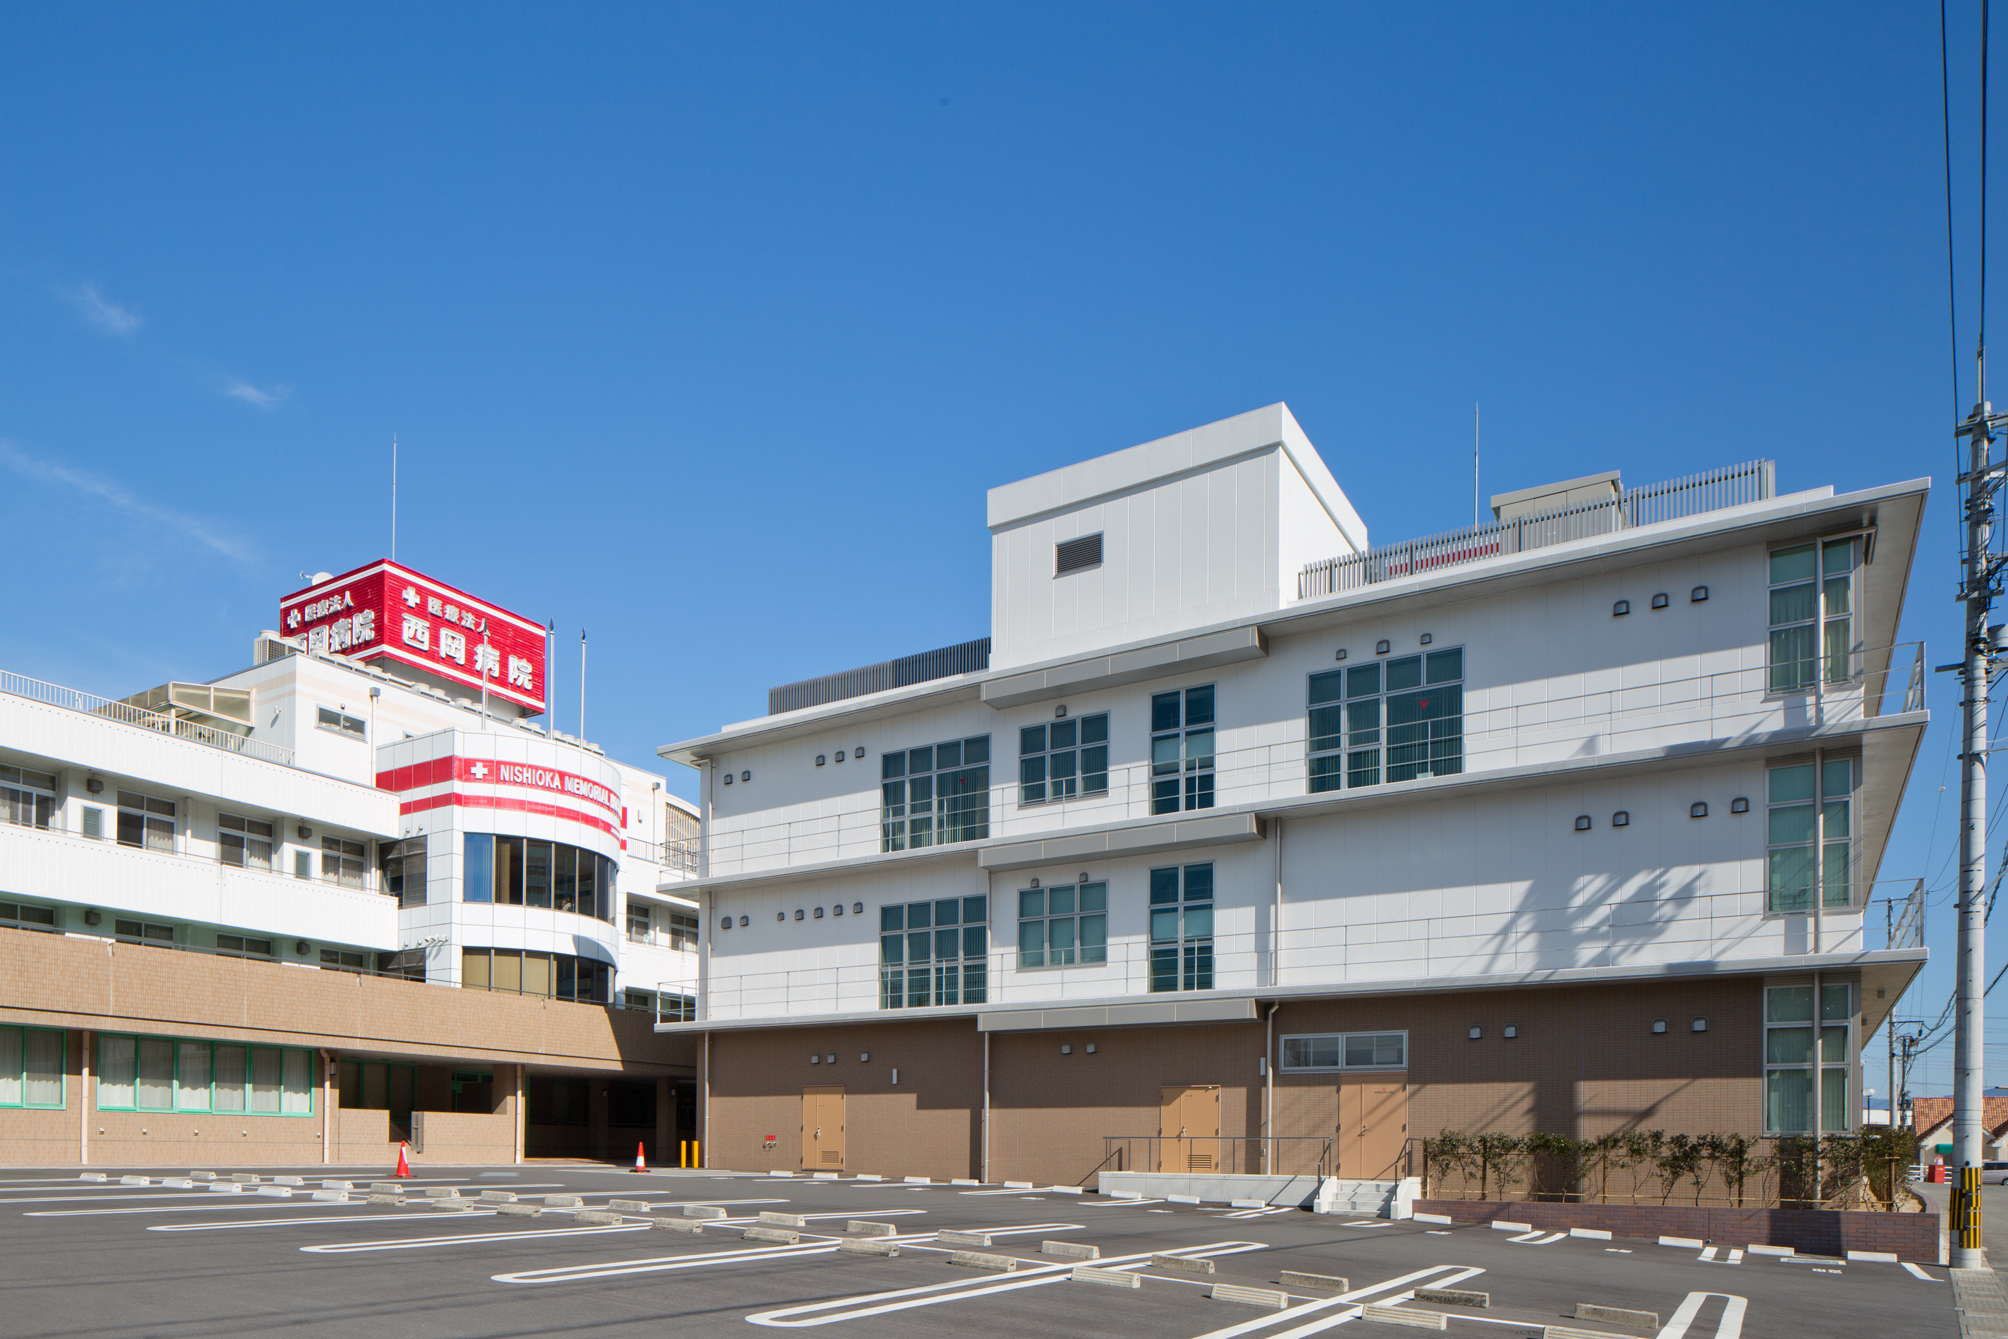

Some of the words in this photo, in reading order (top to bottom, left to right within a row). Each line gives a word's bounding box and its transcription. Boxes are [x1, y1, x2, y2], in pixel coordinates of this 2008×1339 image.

[304, 590, 354, 622] 医療法人
[428, 596, 490, 637] 医療法人
[402, 613, 532, 690] 西岡病院
[500, 764, 561, 790] NISHIOKA
[564, 775, 609, 807] MEMORIAL
